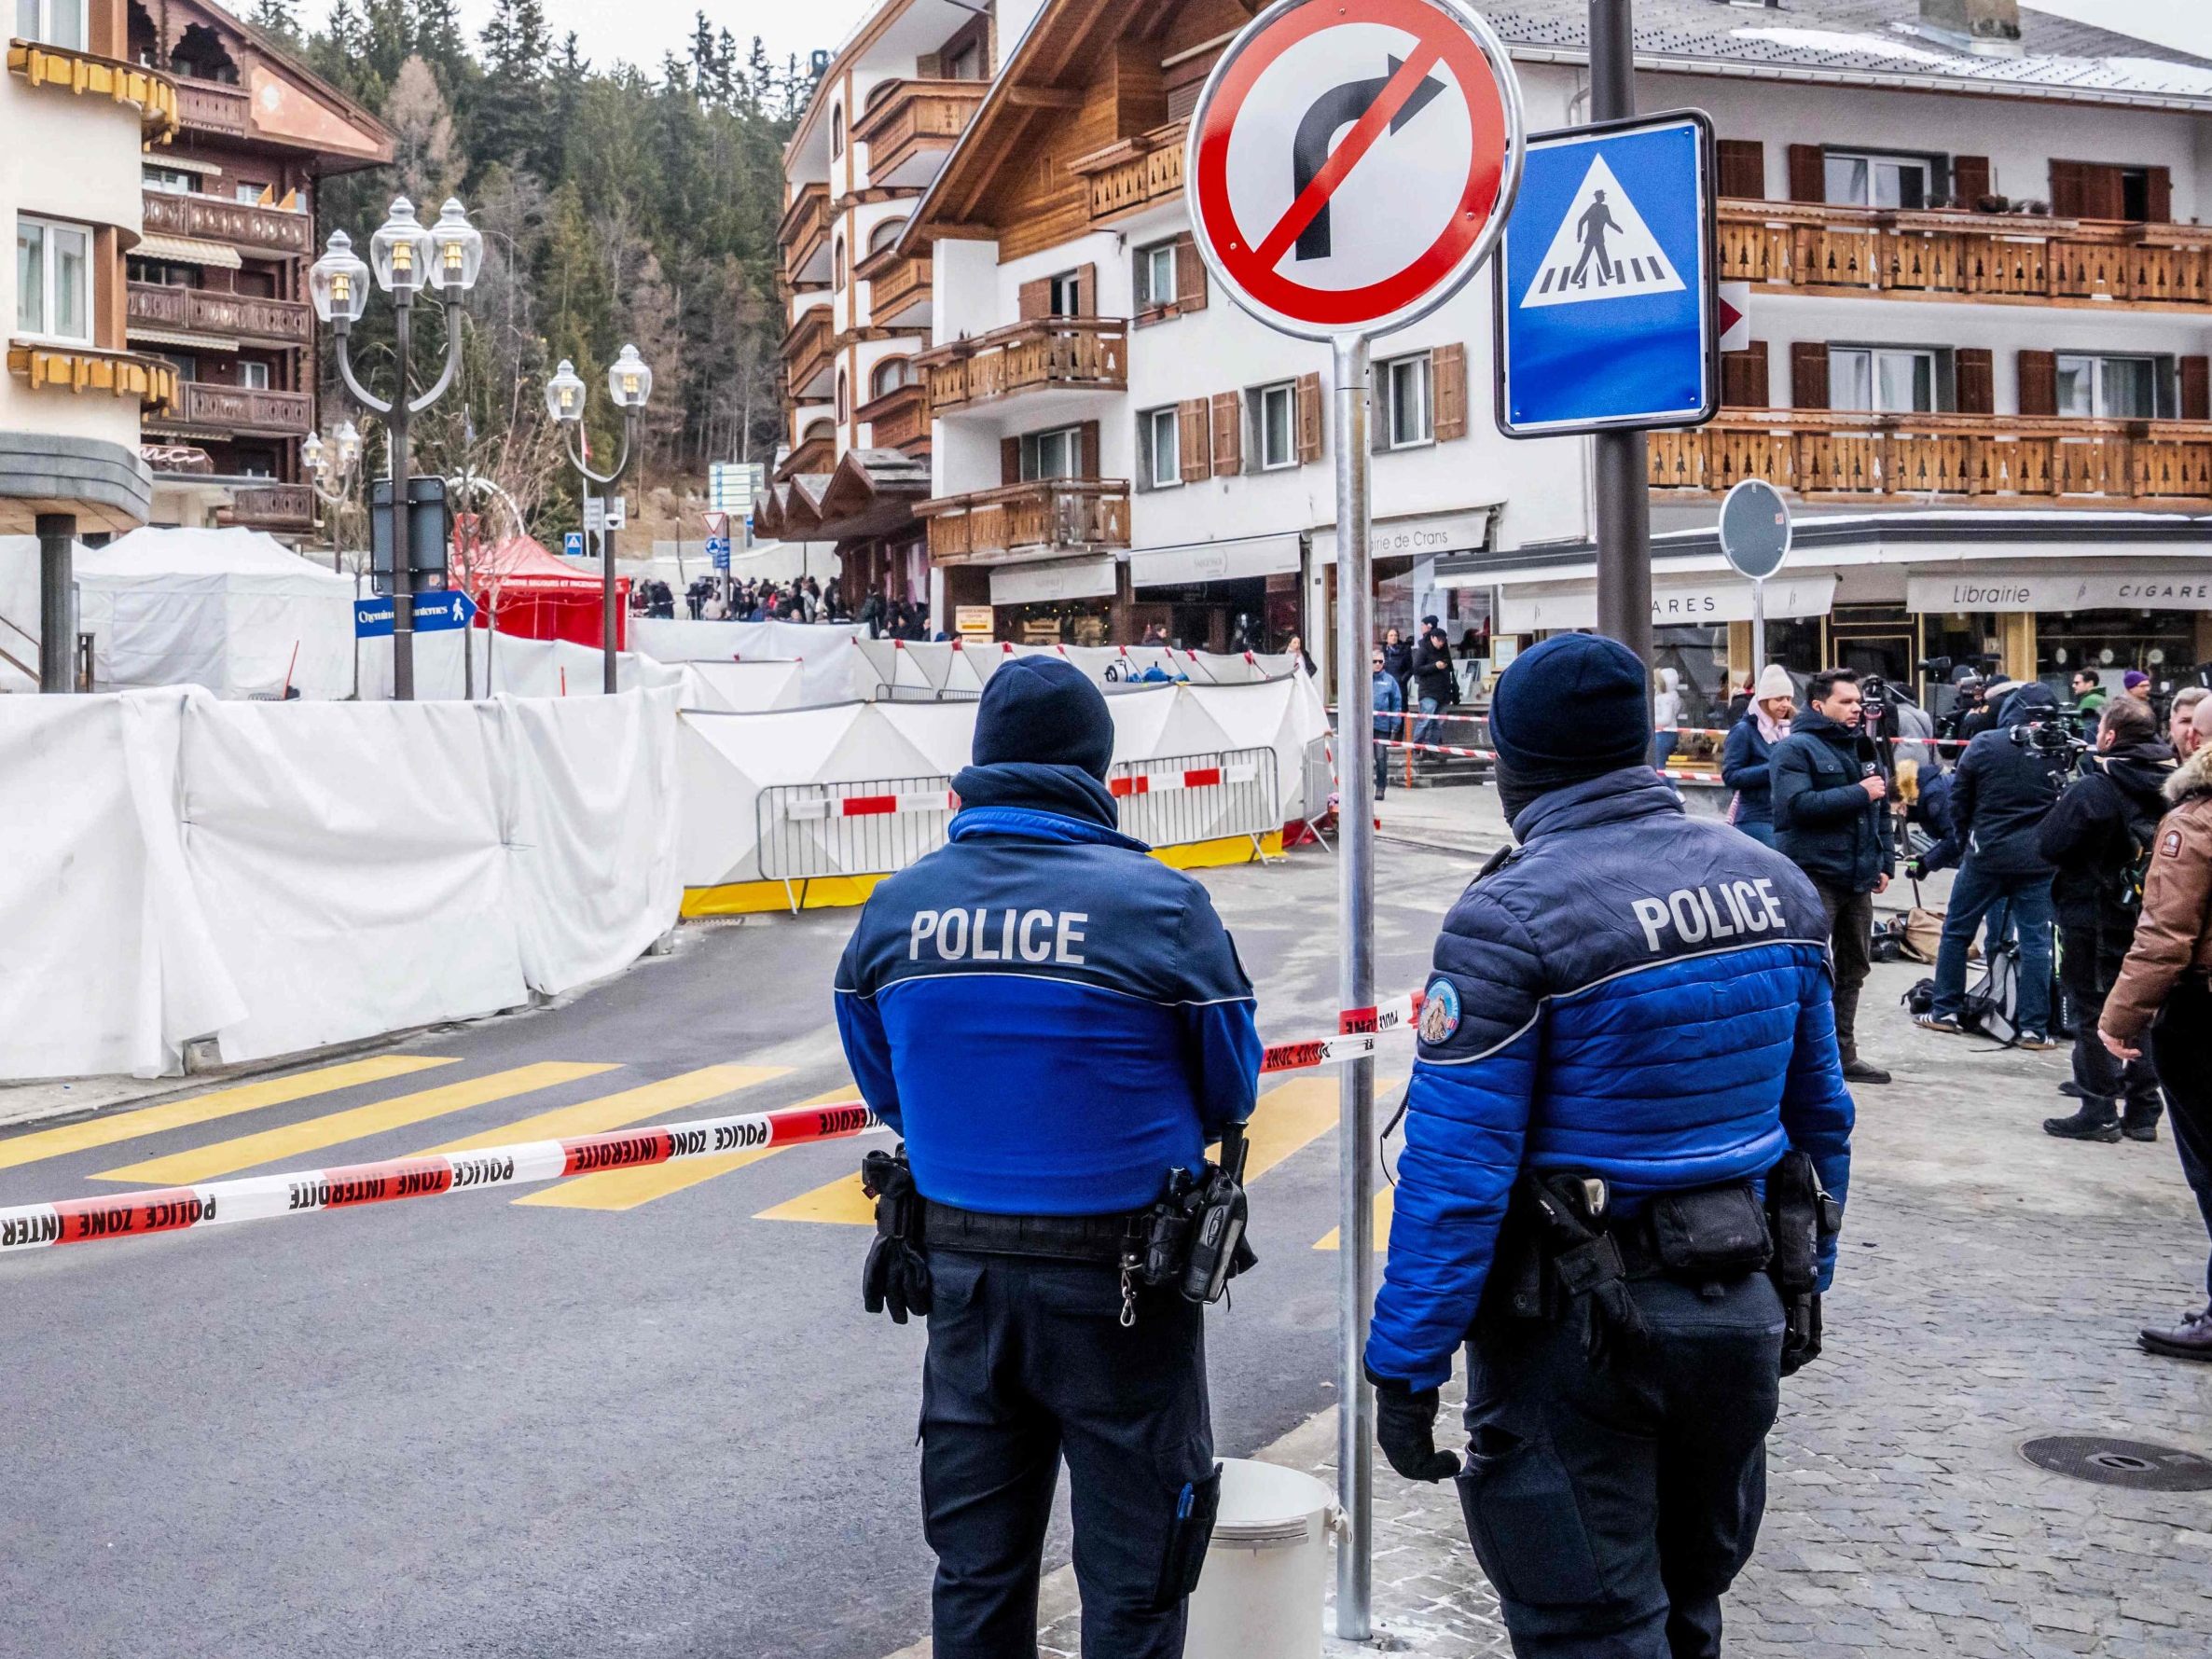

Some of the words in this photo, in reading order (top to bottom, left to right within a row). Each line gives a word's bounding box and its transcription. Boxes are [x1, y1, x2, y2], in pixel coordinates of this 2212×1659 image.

[1394, 533, 1409, 549] de
[1414, 531, 1448, 546] Crans
[1652, 597, 1716, 615] ARES
[1953, 586, 2030, 603] Librairie
[2118, 585, 2207, 598] CIGARE
[1631, 878, 1787, 952] POLICE
[909, 907, 1088, 964] POLICE
[668, 1130, 707, 1155] ZONE
[714, 1122, 767, 1152] POLICE
[574, 1137, 658, 1170] INTERDITE
[398, 1166, 444, 1195] ZONE
[453, 1156, 515, 1186] POLICE
[288, 1172, 386, 1210] INTERDITE
[79, 1207, 133, 1237] ZONE
[145, 1194, 216, 1228] POLICE
[2, 1214, 64, 1246] INTER
